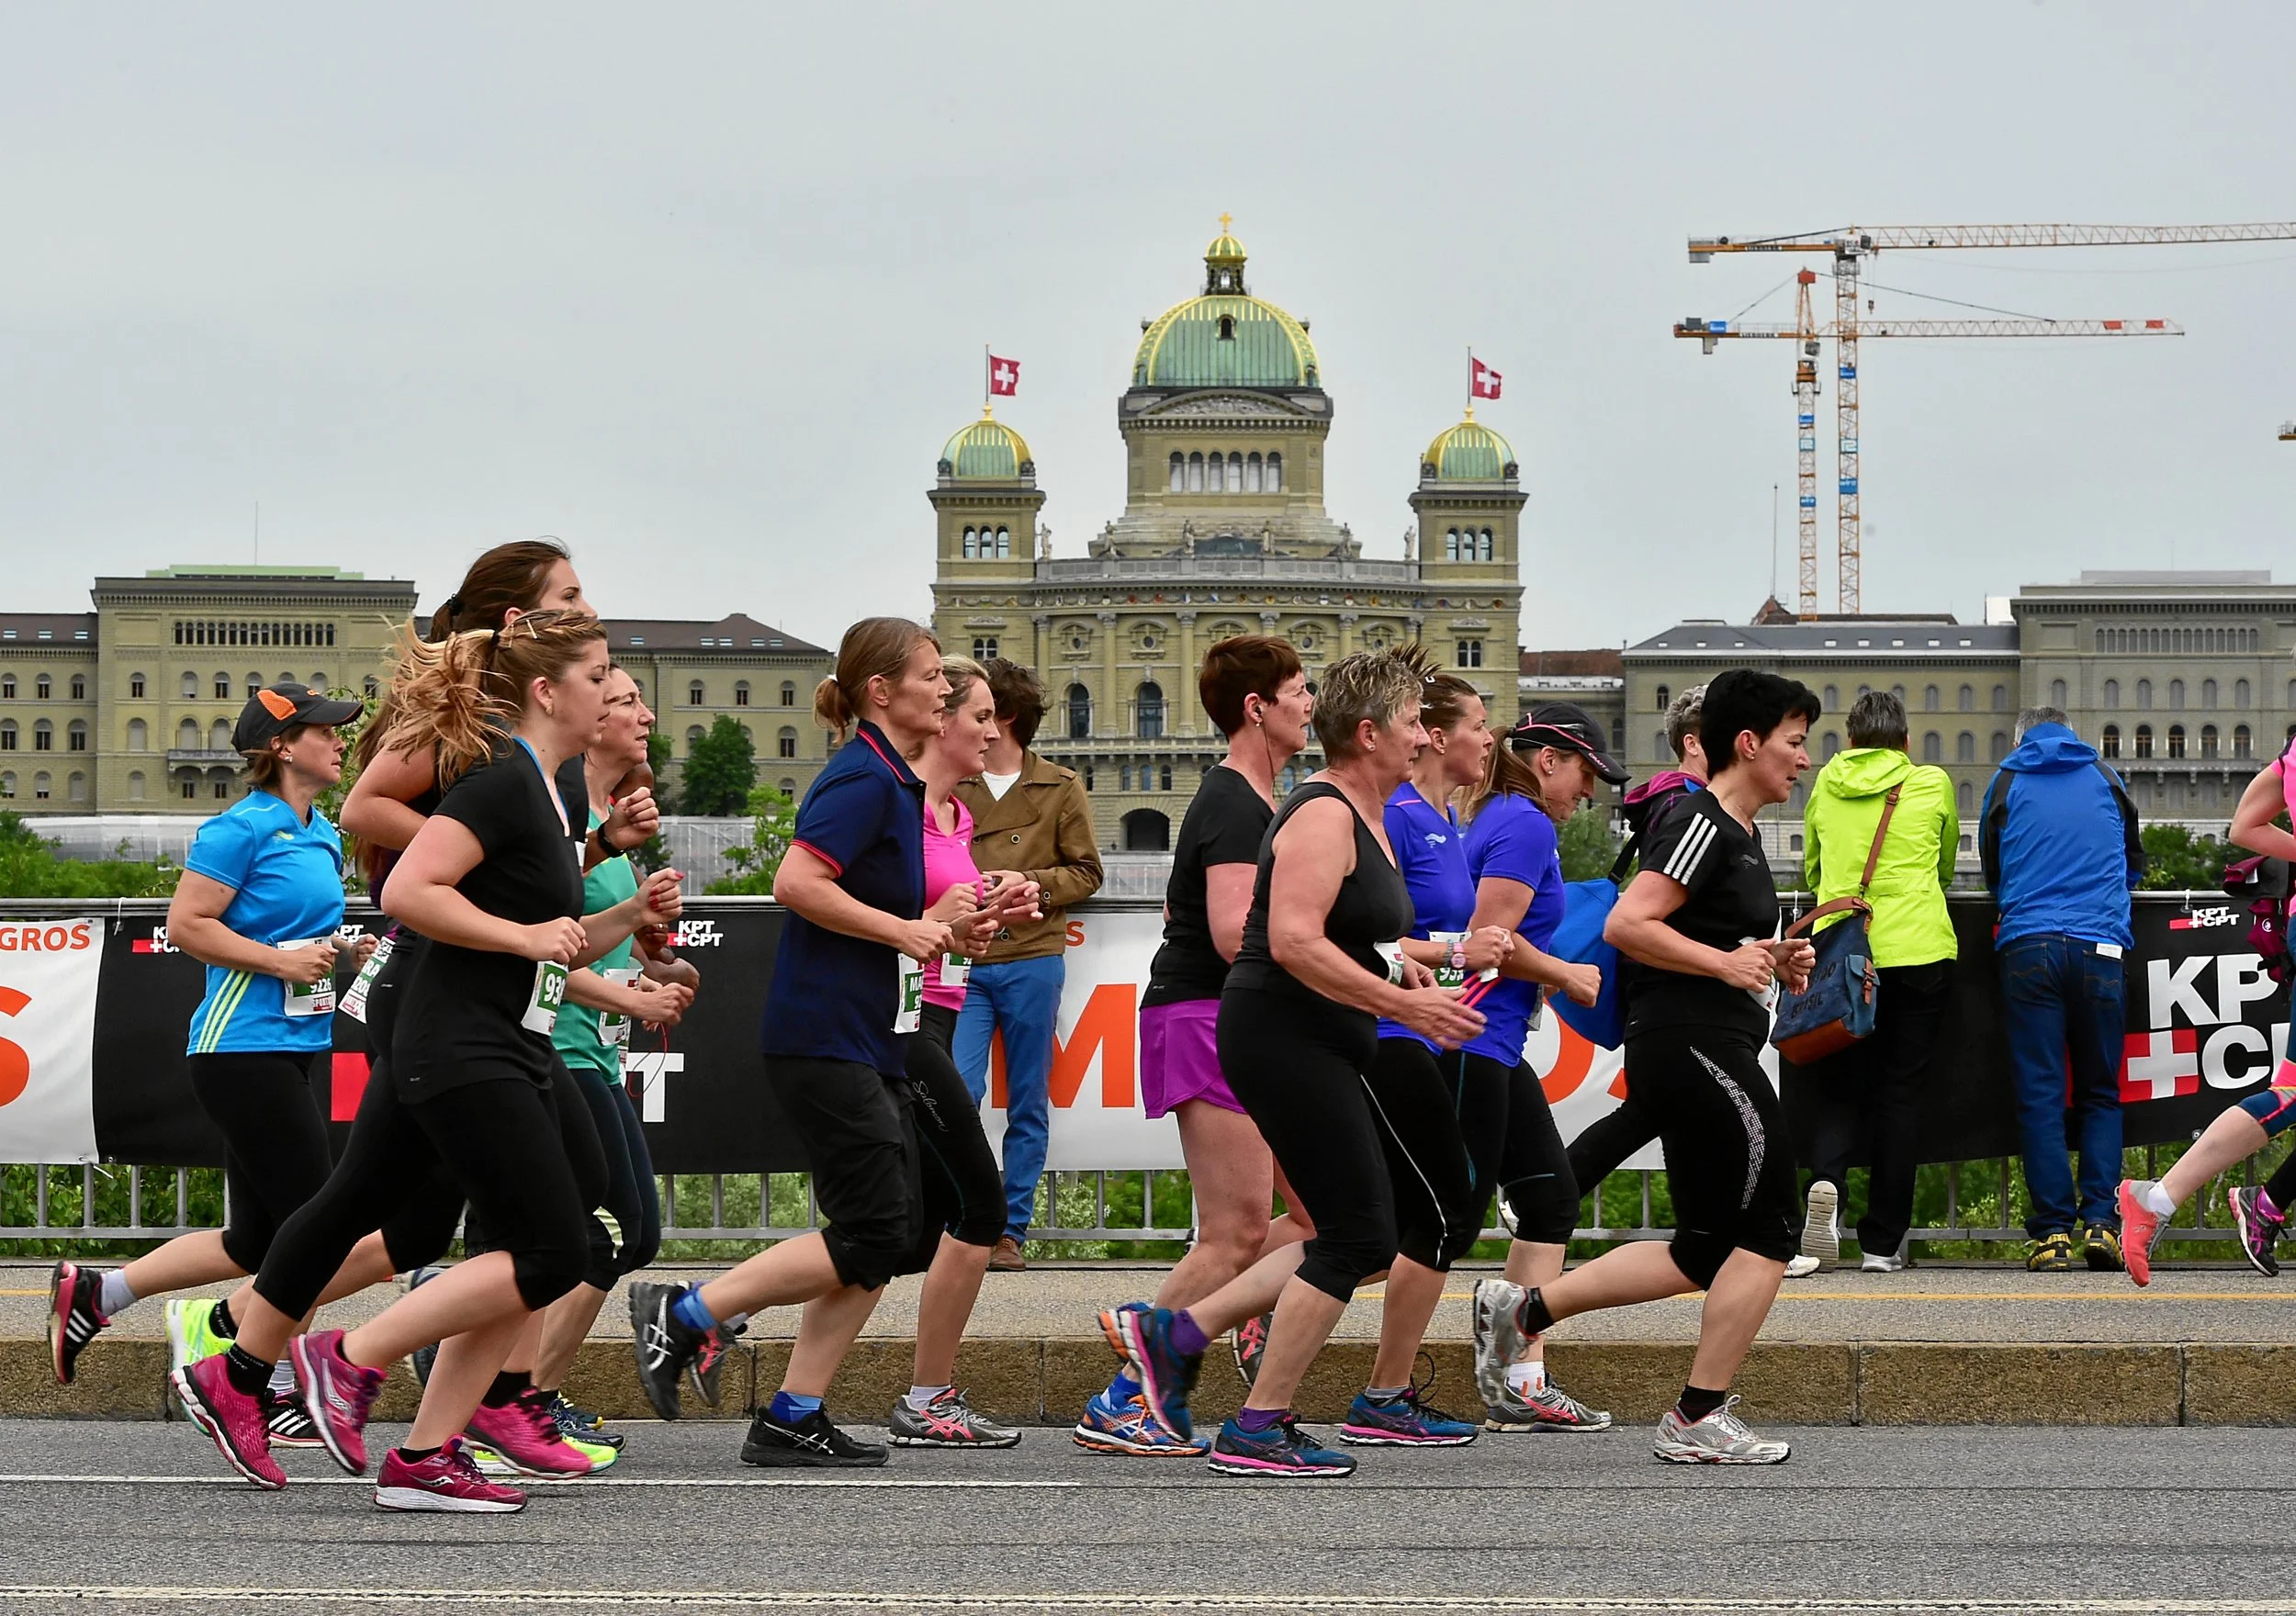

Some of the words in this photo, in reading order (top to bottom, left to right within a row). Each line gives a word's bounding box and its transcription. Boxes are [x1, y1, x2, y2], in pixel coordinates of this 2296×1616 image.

[1588, 752, 1610, 772] CRAFT
[2191, 906, 2230, 919] KPT
[678, 920, 715, 934] KPT
[0, 924, 91, 951] GROS
